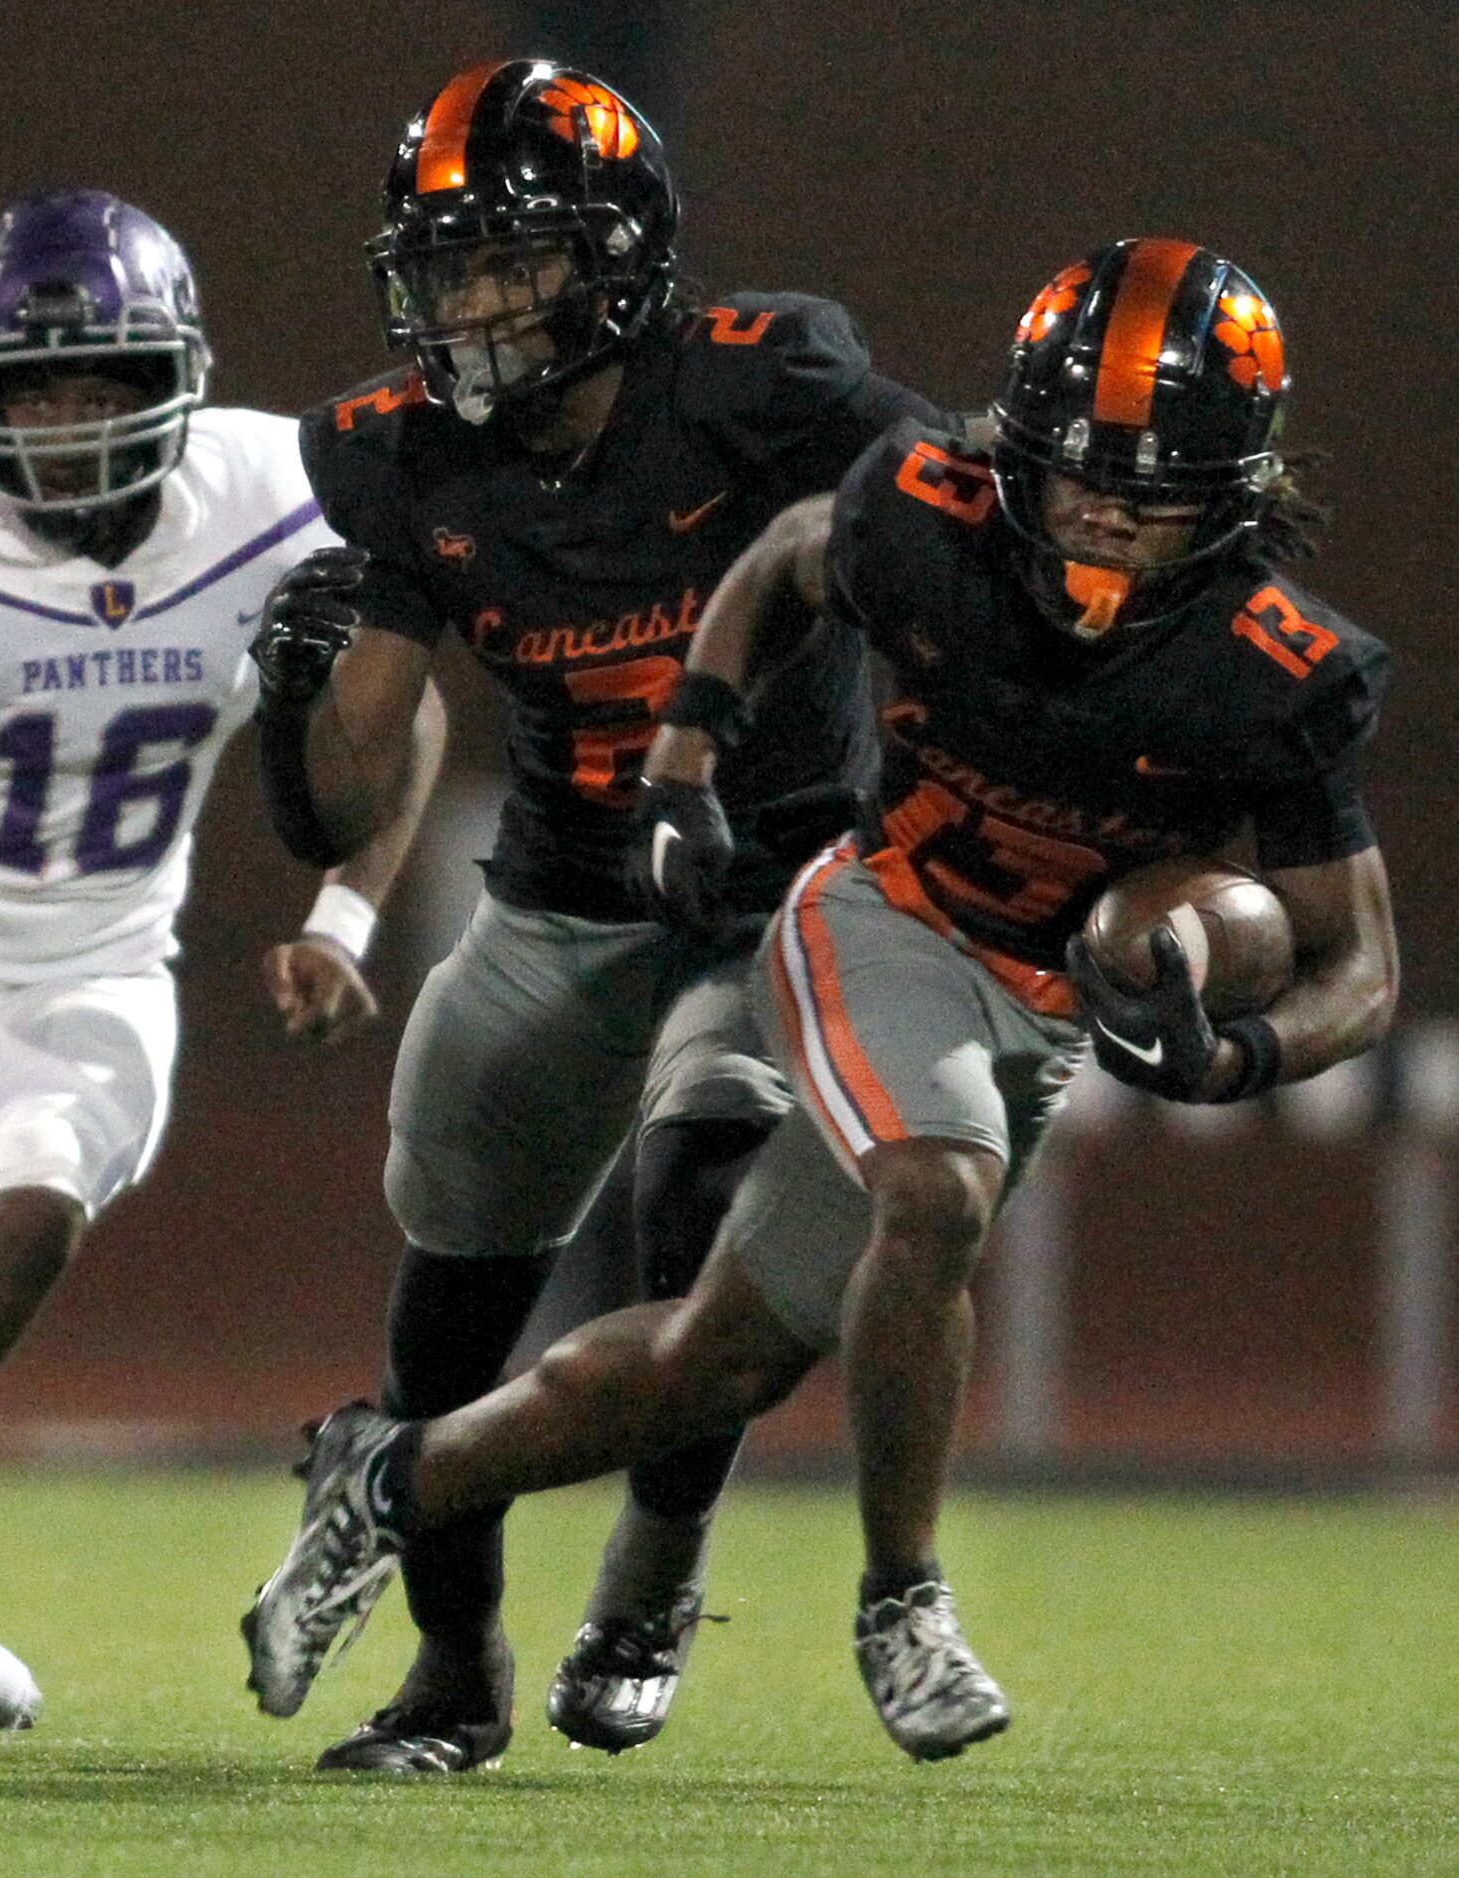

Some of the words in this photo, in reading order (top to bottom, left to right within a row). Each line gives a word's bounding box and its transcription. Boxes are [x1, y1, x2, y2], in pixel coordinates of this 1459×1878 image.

[105, 587, 126, 618] L
[472, 587, 708, 668] Lancast
[1232, 586, 1340, 680] 13
[22, 648, 203, 693] PANTHERS
[564, 656, 684, 812] 2
[880, 780, 1109, 925] 13
